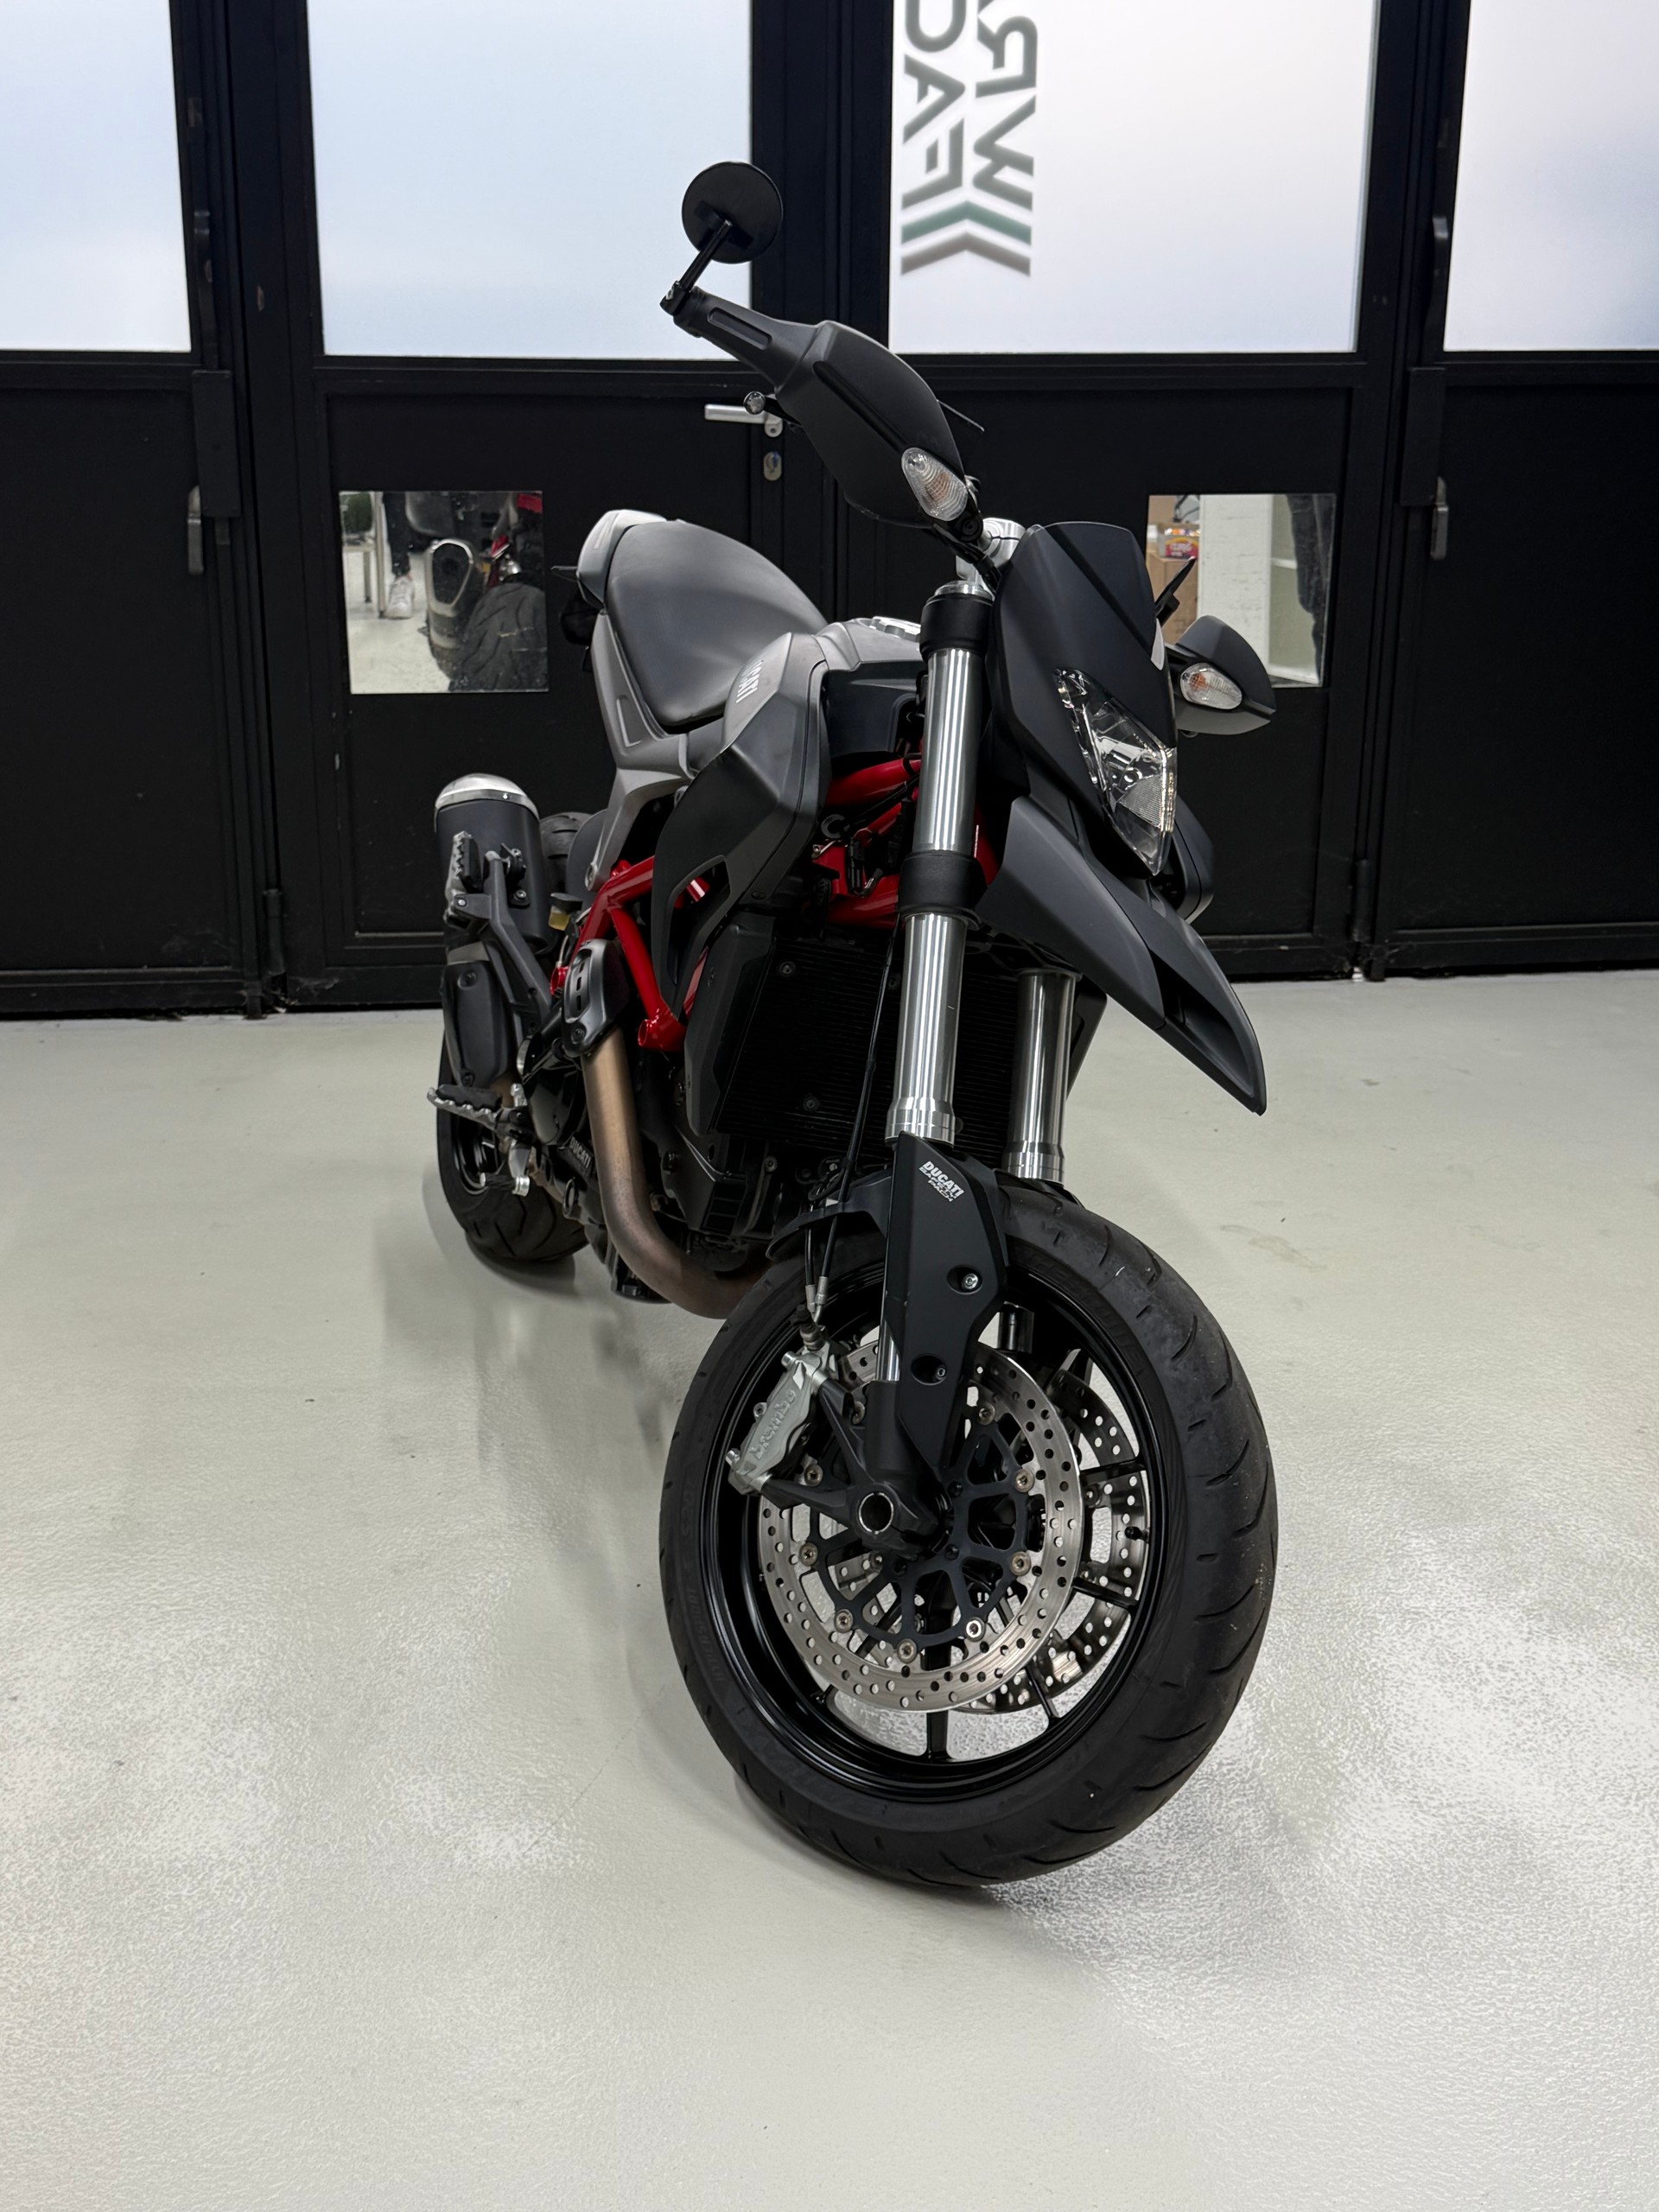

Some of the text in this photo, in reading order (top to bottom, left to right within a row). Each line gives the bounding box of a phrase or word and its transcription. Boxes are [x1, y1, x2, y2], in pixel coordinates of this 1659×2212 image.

[569, 1136, 592, 1169] DUCATI
[922, 1160, 965, 1198] DUCATI
[749, 1389, 797, 1460] brembo
